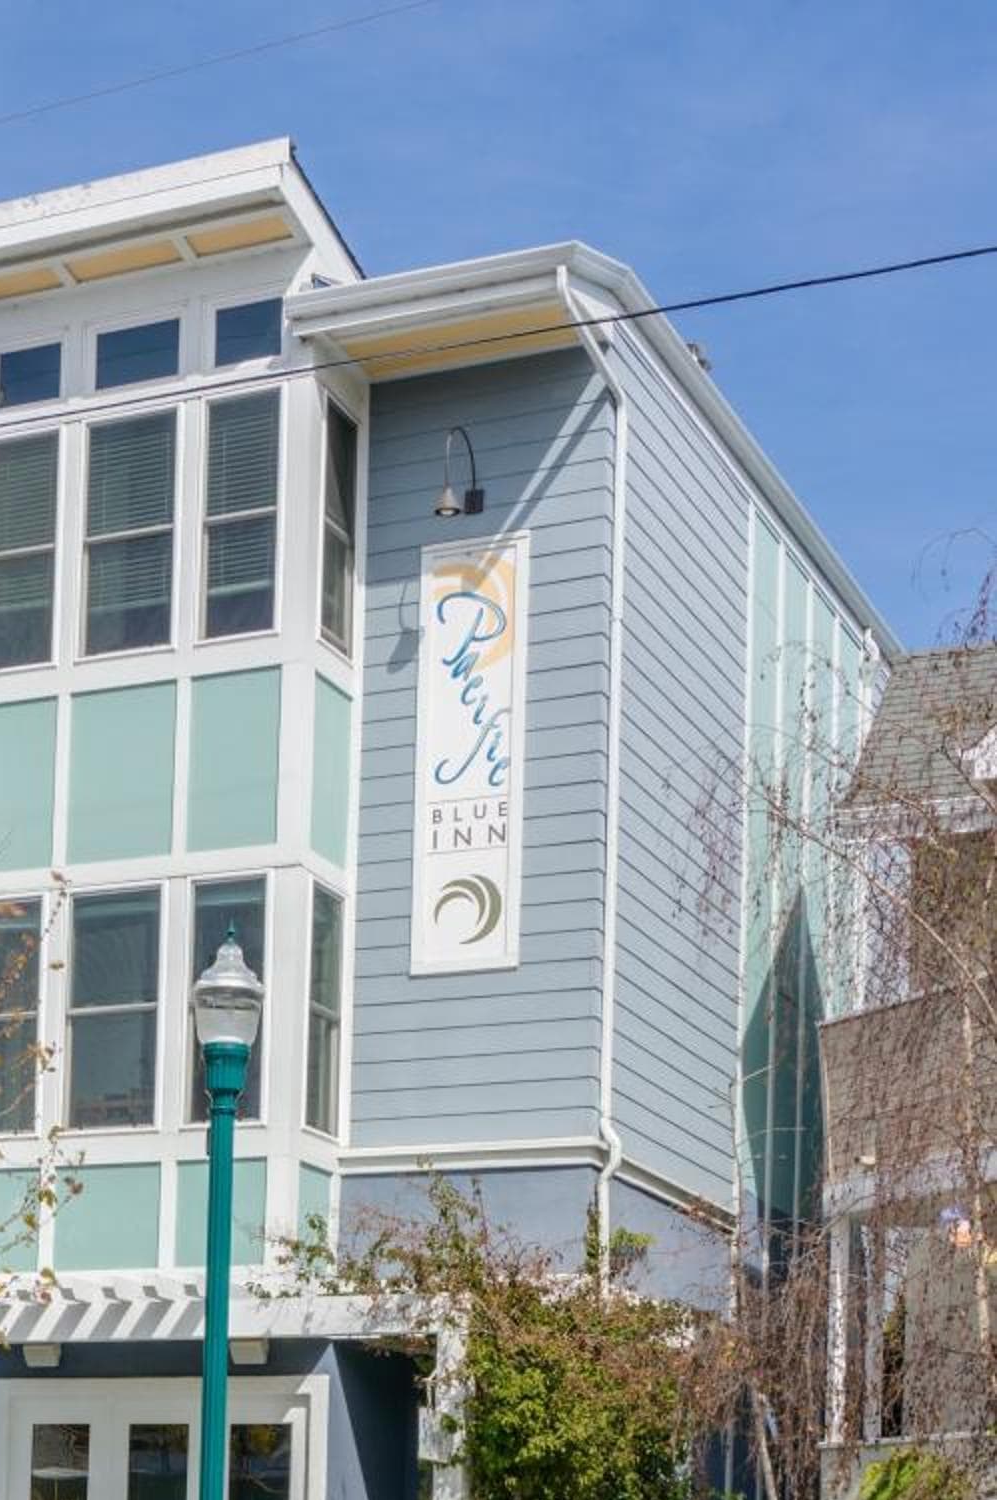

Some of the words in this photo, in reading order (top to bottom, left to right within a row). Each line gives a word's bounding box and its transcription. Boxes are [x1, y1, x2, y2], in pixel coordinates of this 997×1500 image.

[435, 591, 511, 787] Pacific
[432, 801, 507, 824] BLUE
[432, 822, 506, 849] INN
